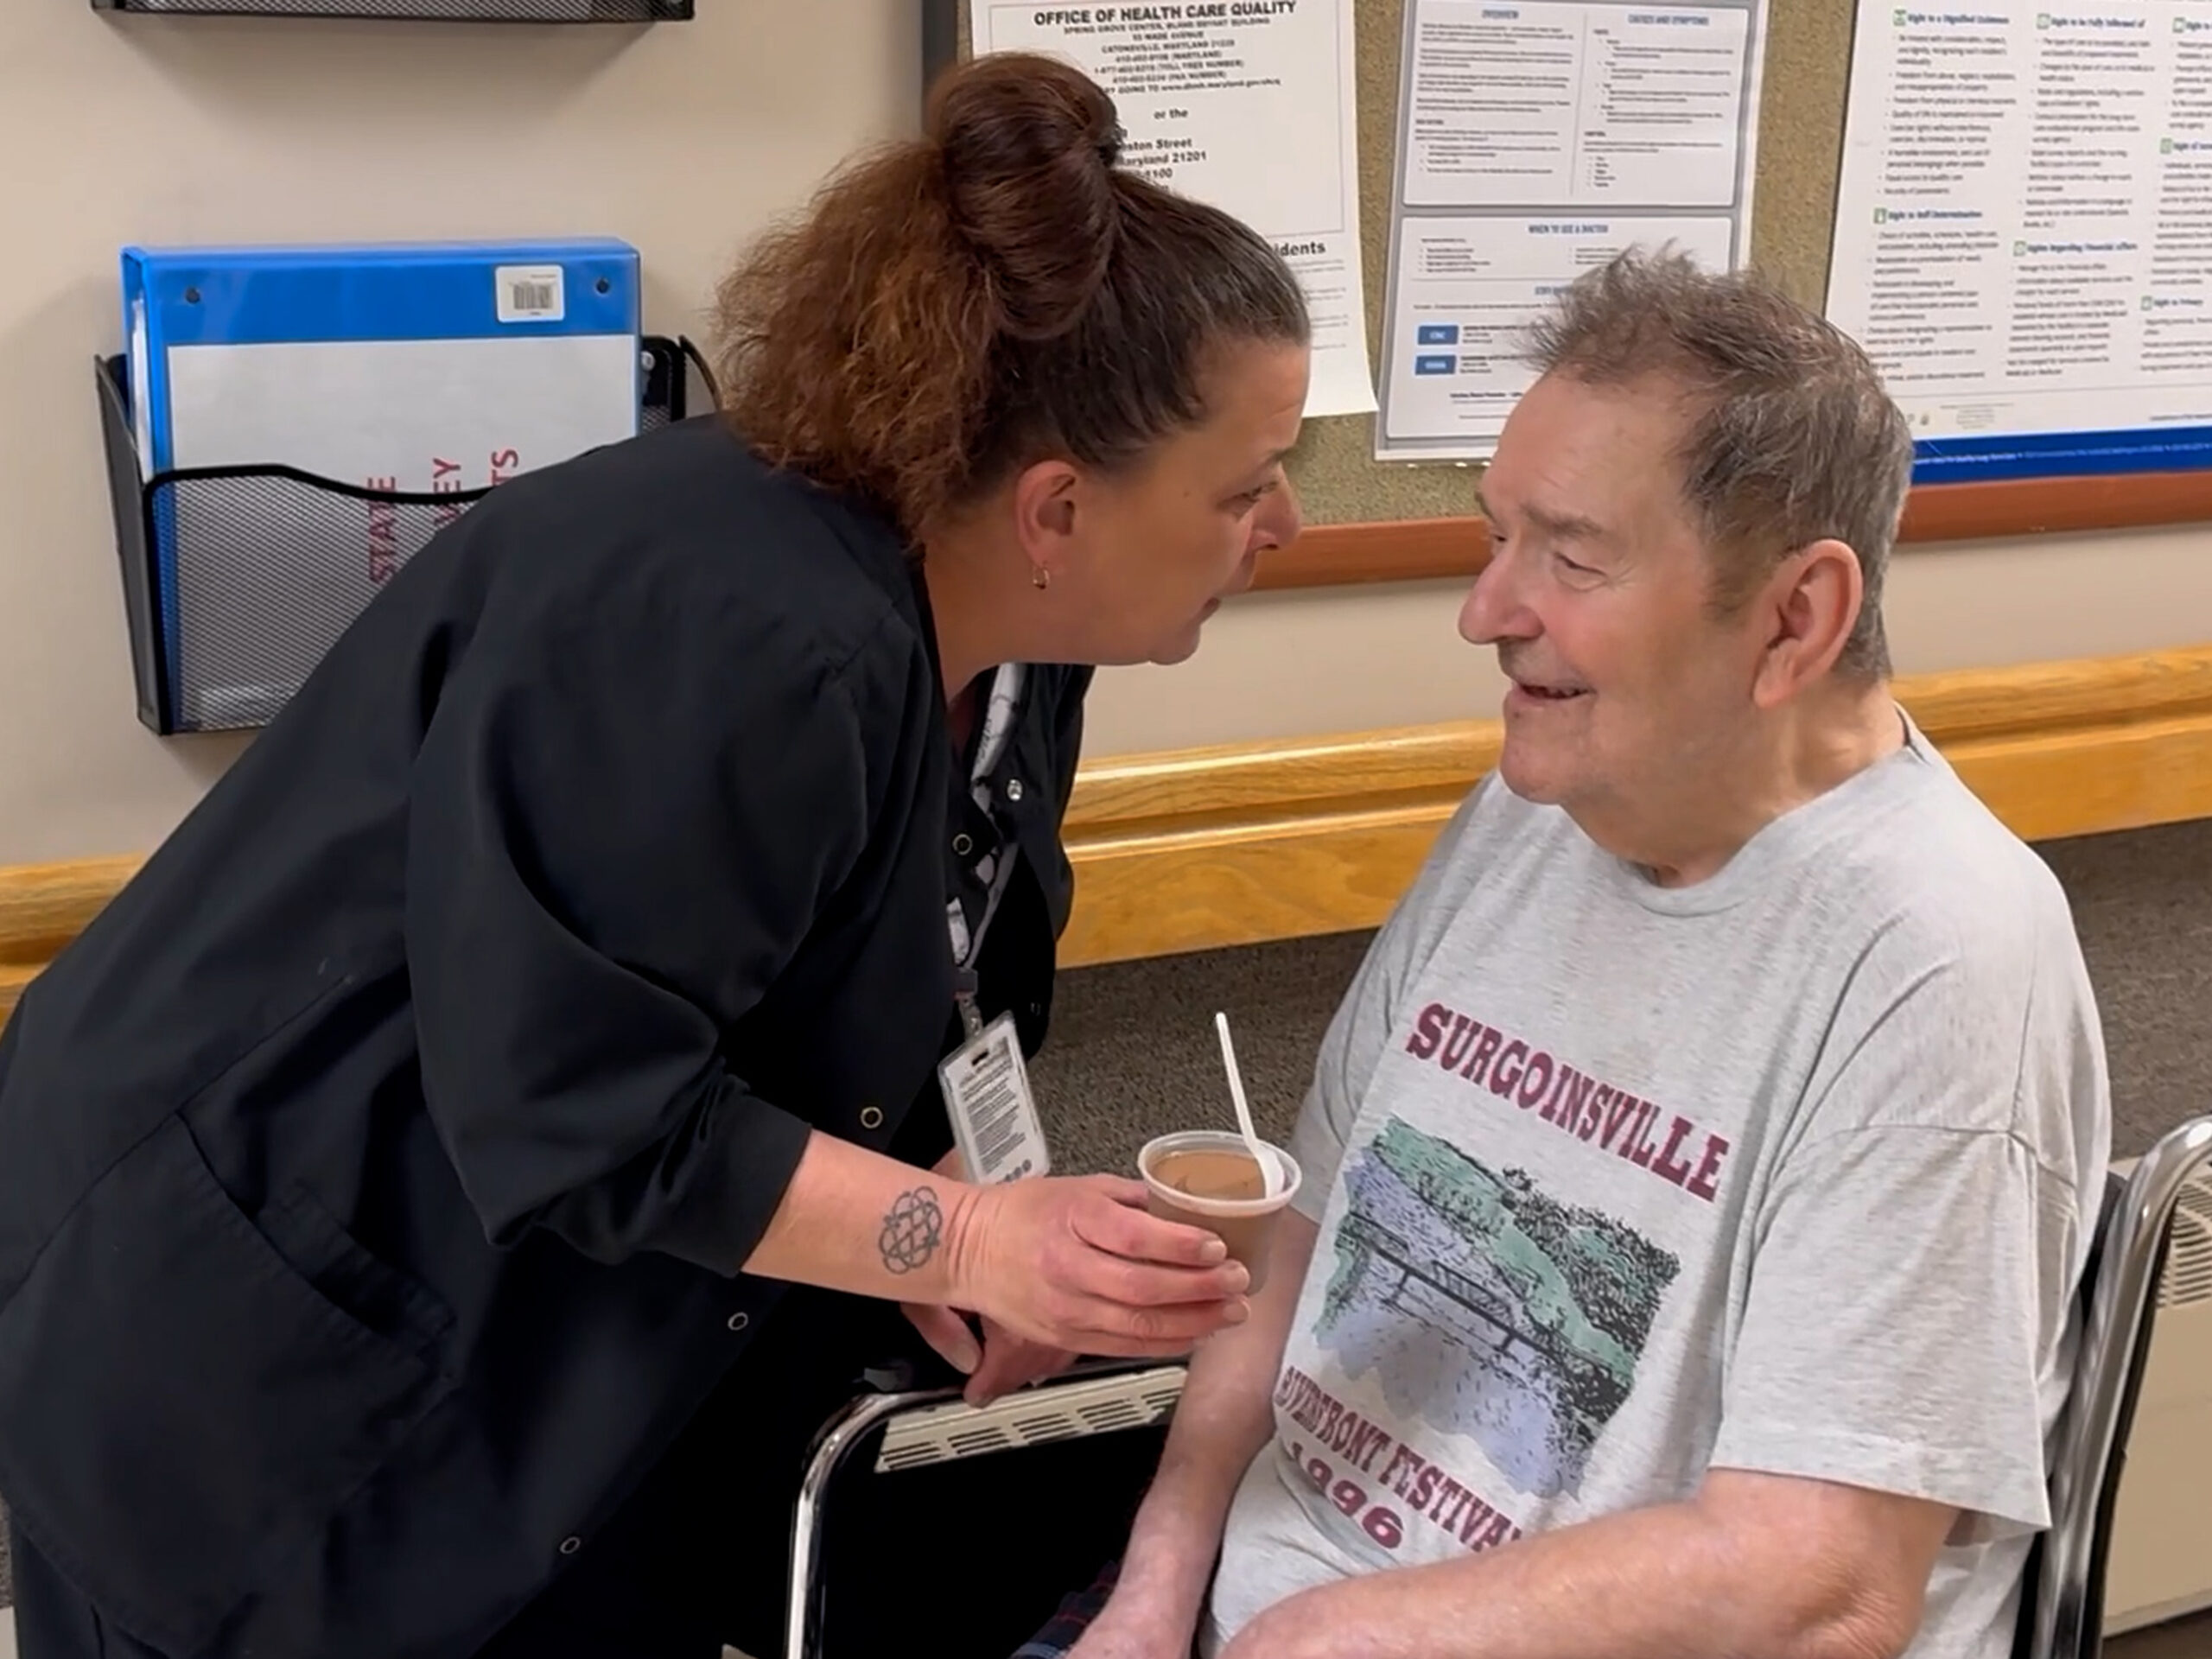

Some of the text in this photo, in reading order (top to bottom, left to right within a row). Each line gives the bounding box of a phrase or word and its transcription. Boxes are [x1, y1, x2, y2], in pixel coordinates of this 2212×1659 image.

[1034, 1, 1296, 26] OFFICE OF HEALTH CARE QUALITY
[1154, 108, 1188, 119] or the
[1156, 138, 1192, 149] Street
[1173, 150, 1206, 163] 21201
[1274, 241, 1326, 257] idents
[367, 477, 396, 585] STATE
[1406, 1003, 1730, 1202] SURGOINSVILLE
[1378, 1443, 1522, 1553] FESTIVA
